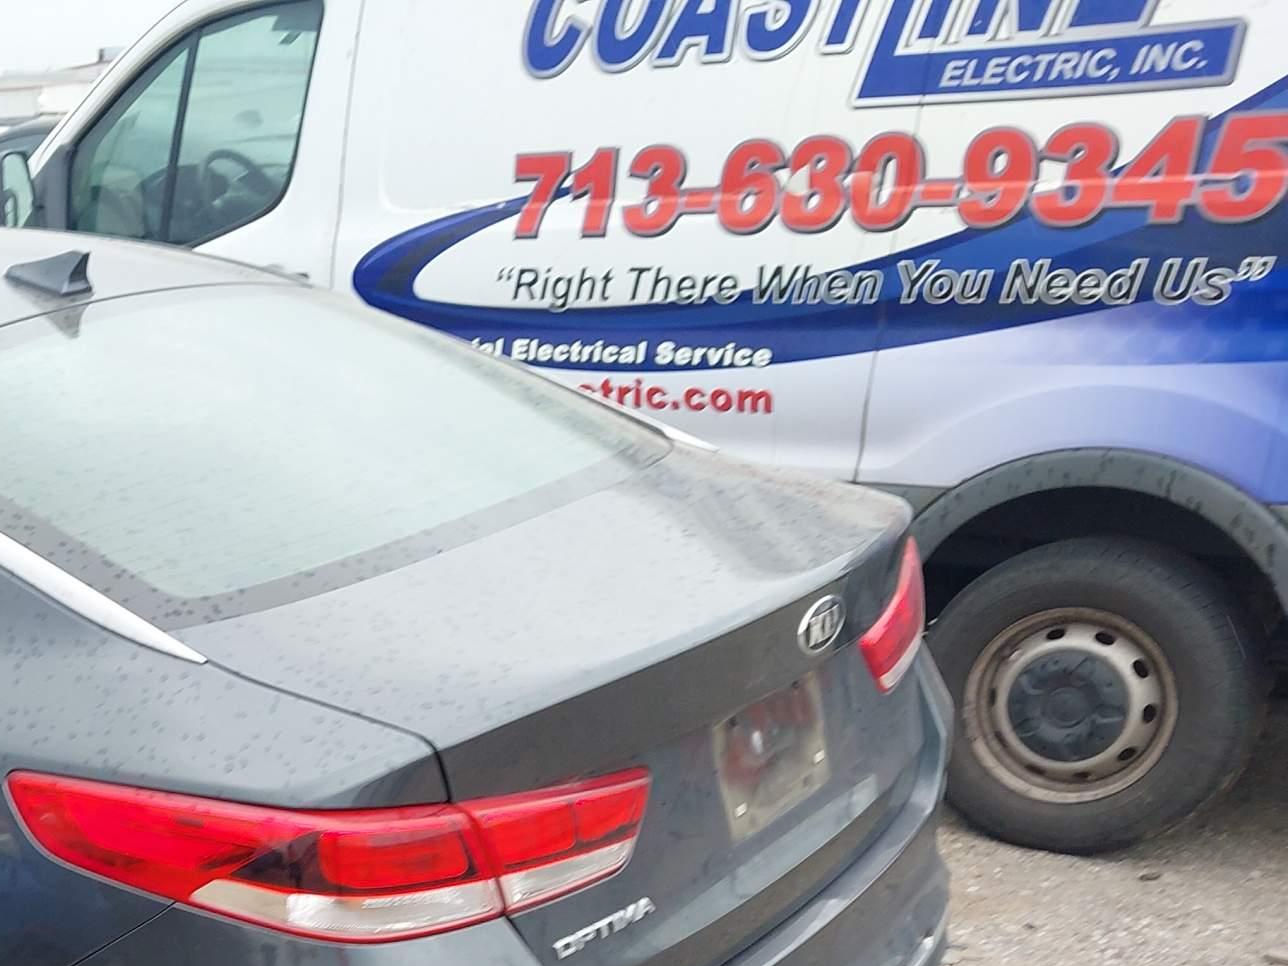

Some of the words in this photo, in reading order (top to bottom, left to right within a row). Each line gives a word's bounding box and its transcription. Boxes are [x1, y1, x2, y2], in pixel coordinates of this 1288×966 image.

[938, 49, 1121, 88] ELECTRIC,
[1129, 39, 1207, 75] INC.
[512, 112, 1288, 239] 713-630-9345
[626, 266, 738, 305] There
[753, 264, 882, 304] When
[897, 258, 996, 305] You
[999, 258, 1149, 305] Need
[511, 338, 648, 365] Electrical
[654, 340, 773, 367] Service
